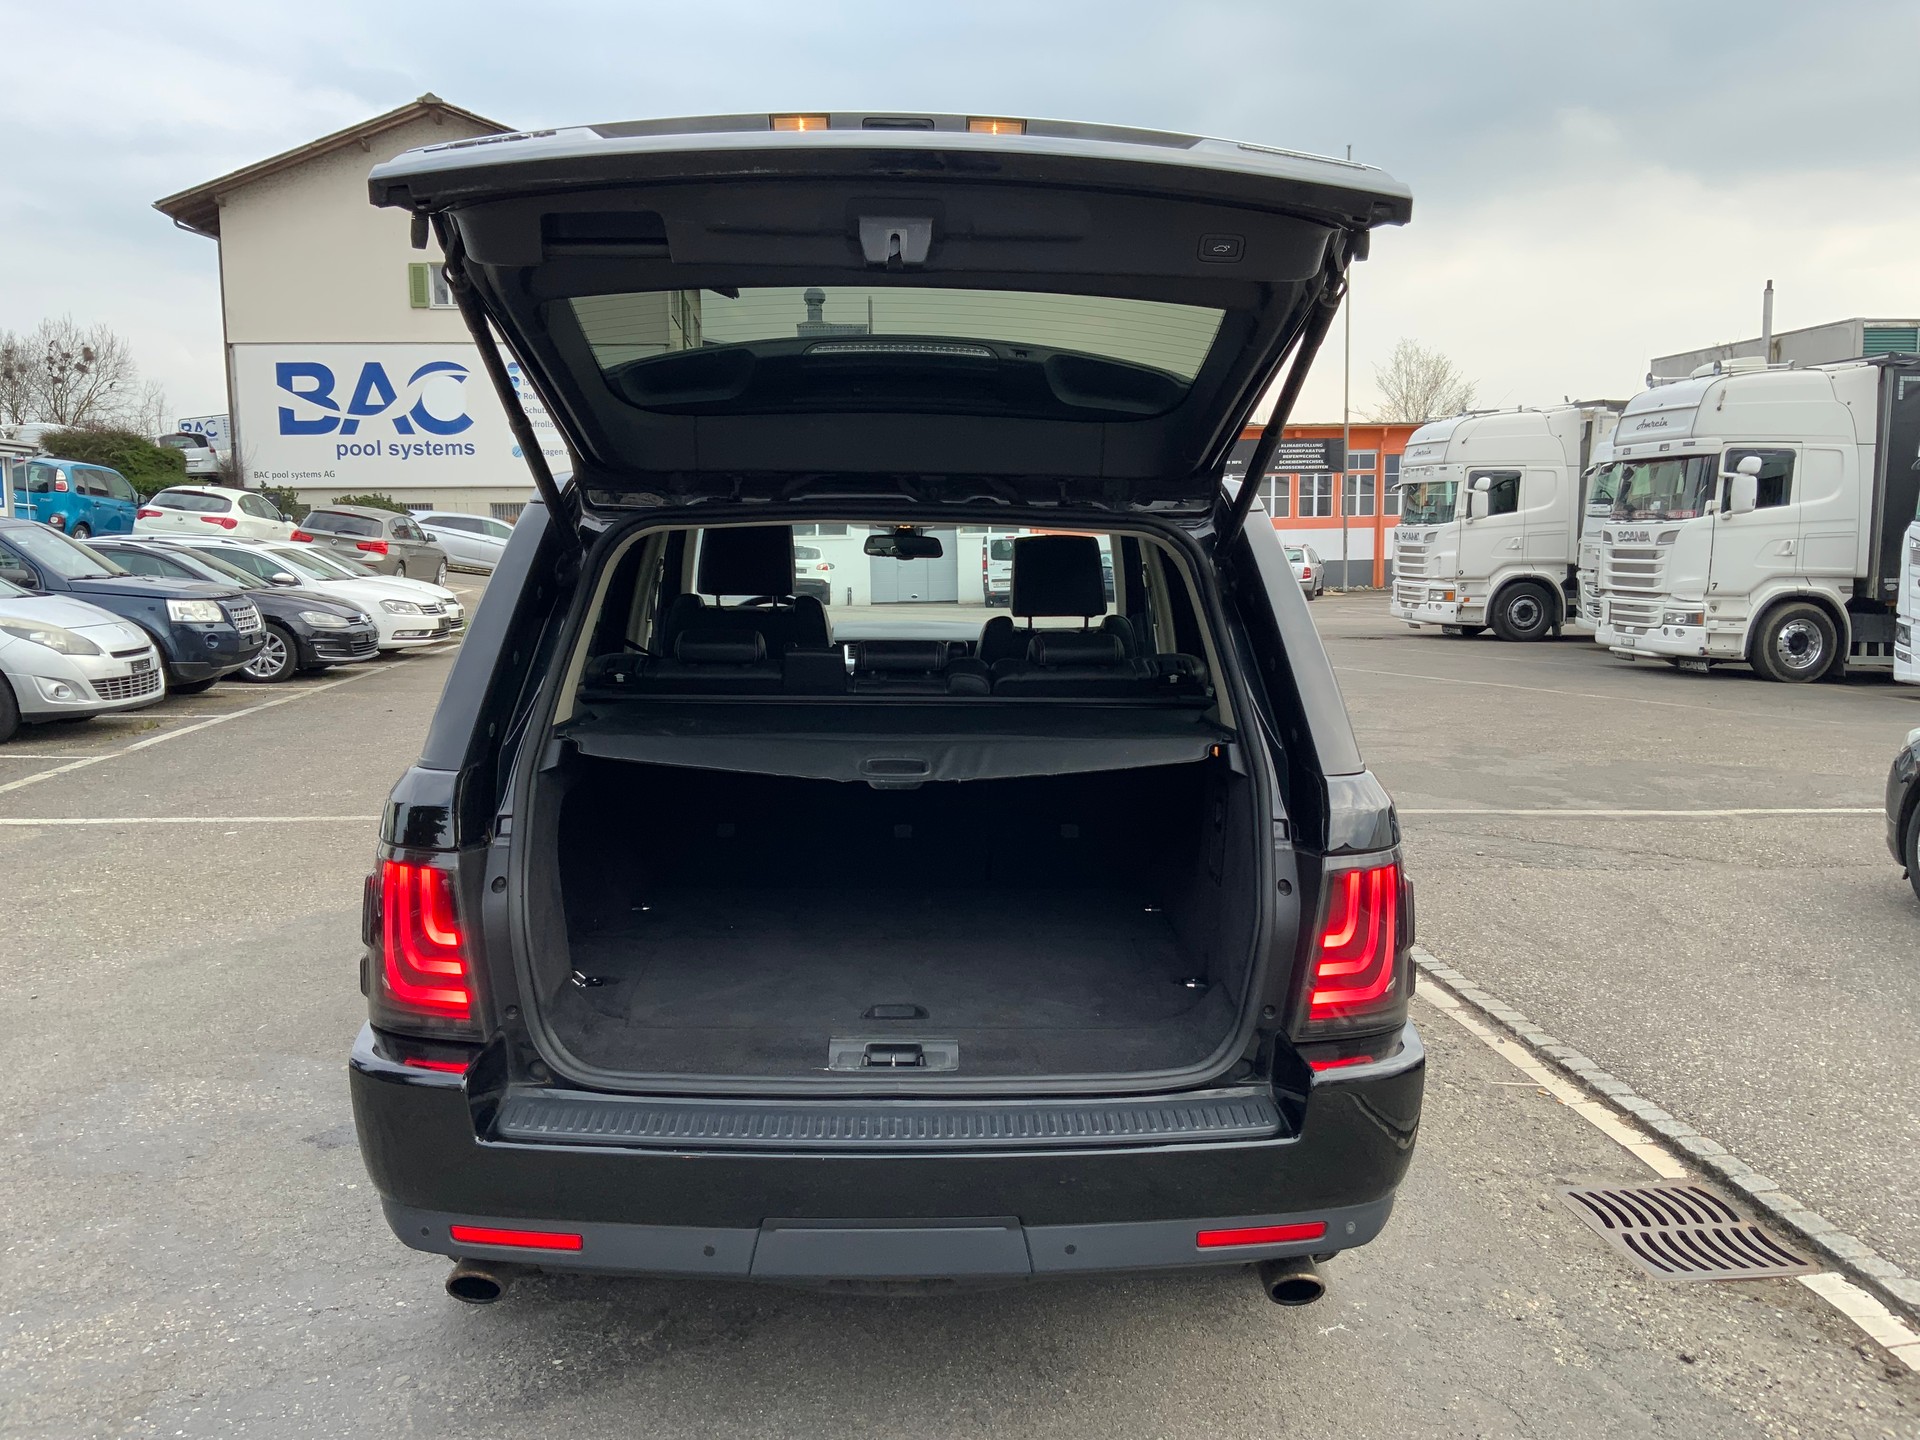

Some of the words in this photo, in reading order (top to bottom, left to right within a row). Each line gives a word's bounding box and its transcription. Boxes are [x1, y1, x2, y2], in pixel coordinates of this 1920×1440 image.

[276, 361, 474, 436] BAC
[524, 406, 548, 414] Schut
[336, 440, 381, 460] pool
[388, 440, 475, 460] systems
[253, 471, 270, 479] BAC
[271, 470, 289, 480] pool
[291, 470, 322, 480] systems
[323, 470, 336, 478] AG
[1617, 531, 1651, 542] SCANIA
[1711, 582, 1718, 590] 7
